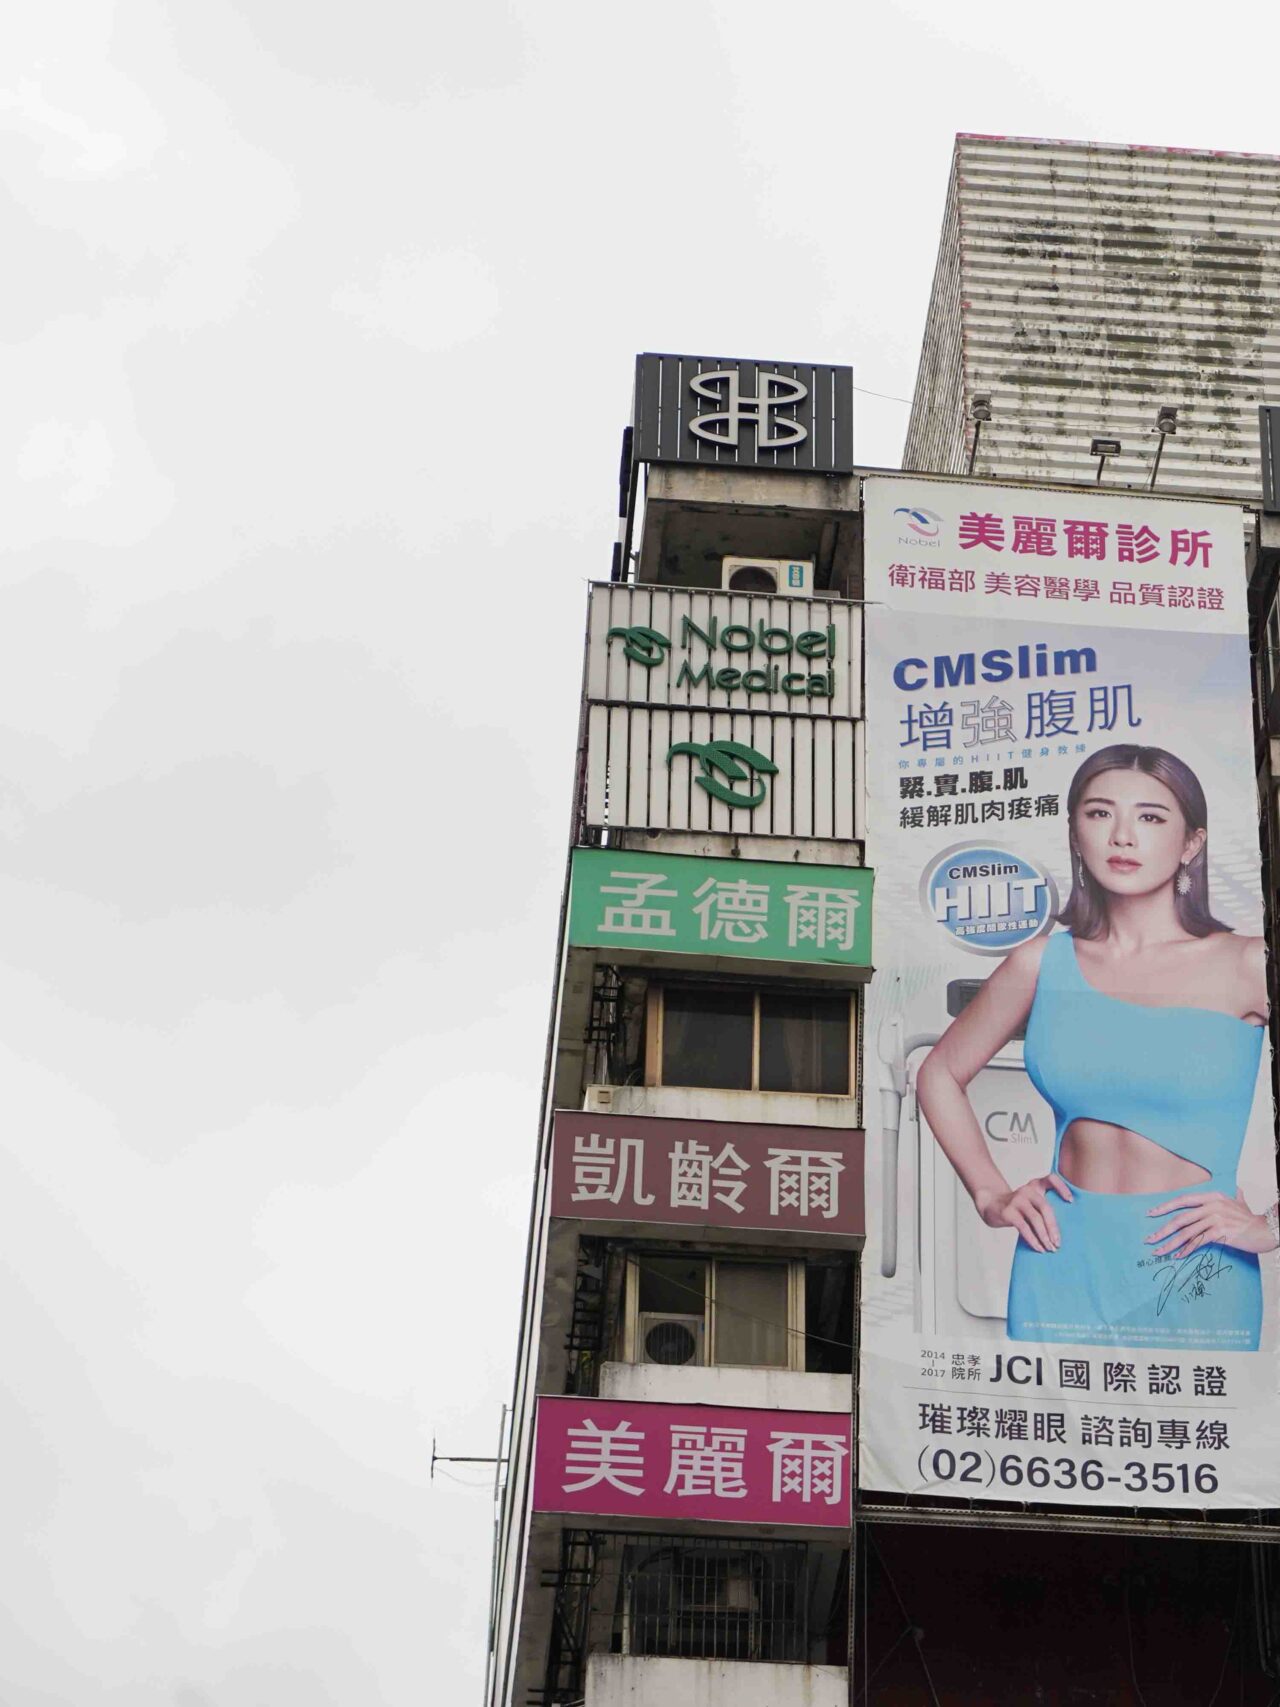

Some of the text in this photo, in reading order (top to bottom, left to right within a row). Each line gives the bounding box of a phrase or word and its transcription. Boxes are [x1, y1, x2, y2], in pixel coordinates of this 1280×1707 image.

[898, 536, 941, 548] Nobel
[958, 511, 1213, 568] 美麗爾診所
[888, 563, 1225, 611] 衛福部 美容醫學 品質認證
[681, 614, 835, 659] Nobel
[676, 659, 835, 698] Medical
[893, 643, 1098, 692] CMSlim
[899, 683, 1142, 752] 增強腹肌
[899, 794, 1060, 829] 緩解肌肉痠痛
[948, 863, 1019, 880] CMSlim
[597, 871, 862, 951] 孟德爾
[935, 878, 1047, 922] HIIT
[570, 1133, 846, 1219] 凱齡爾
[921, 1349, 945, 1360] 2014
[921, 1367, 946, 1378] 2017
[989, 1354, 1228, 1397] JCI 國際認證
[918, 1403, 1231, 1452] 璀璨耀眼 諮詢專線
[562, 1419, 849, 1505] 美麗爾
[916, 1445, 1219, 1496] (02)6636-3516
